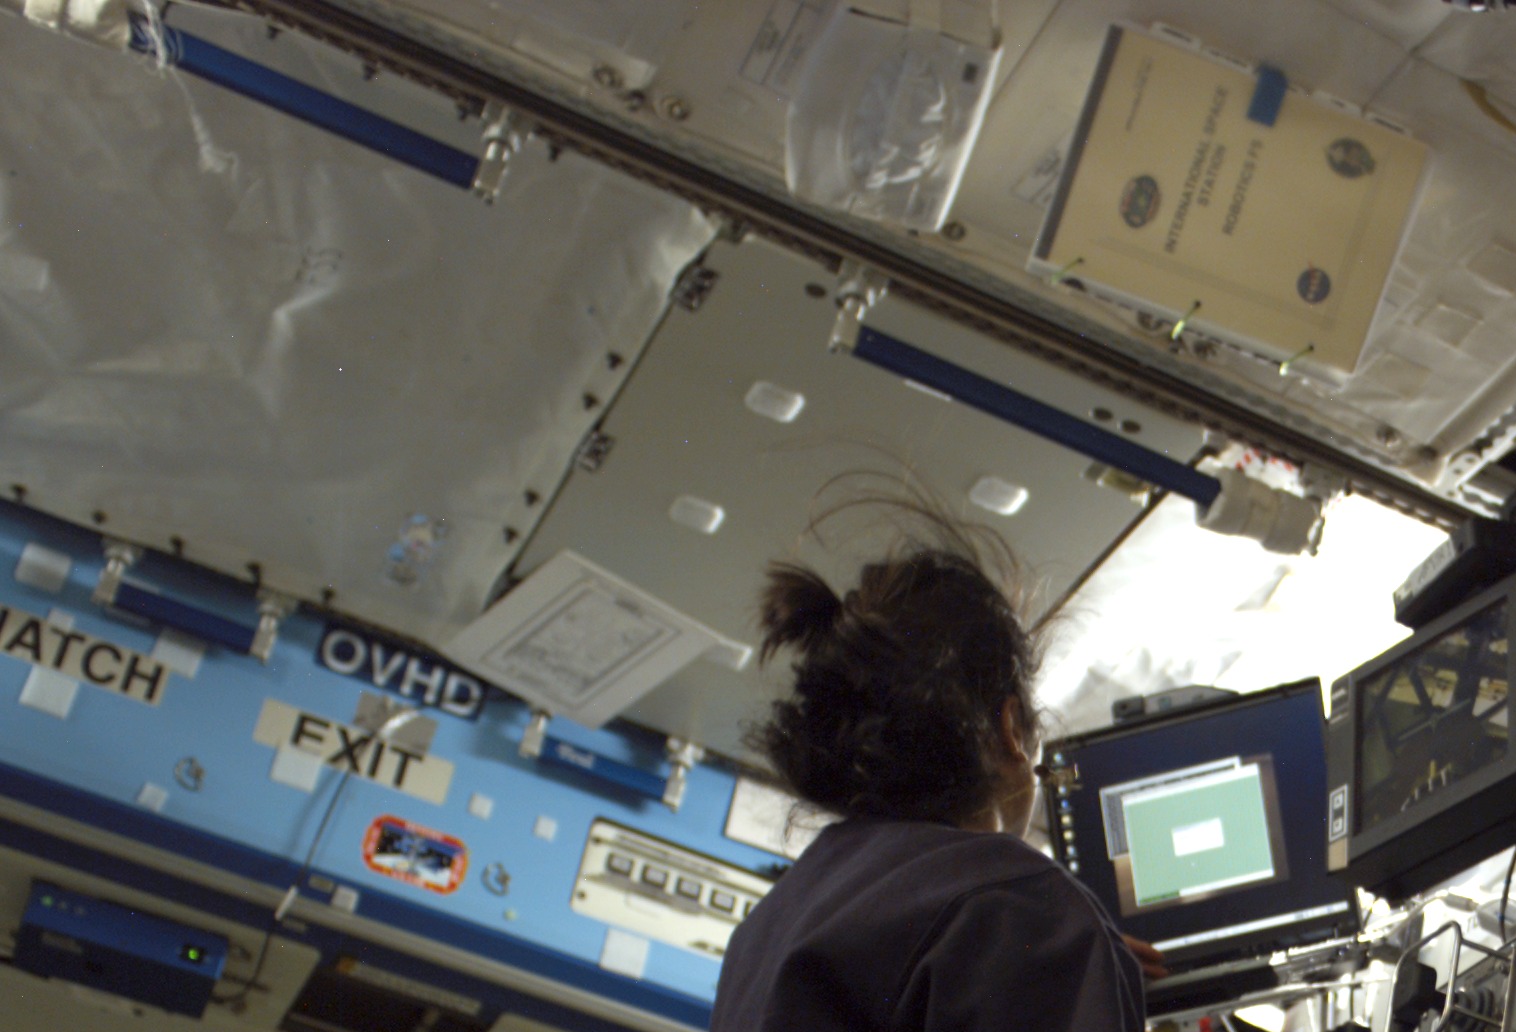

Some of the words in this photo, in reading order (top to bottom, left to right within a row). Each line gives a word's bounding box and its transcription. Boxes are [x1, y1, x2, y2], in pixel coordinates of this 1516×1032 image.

[1165, 142, 1210, 253] INTERNATIONAL
[1204, 85, 1229, 134] SPACE
[1197, 144, 1226, 208] STATION
[1222, 160, 1256, 236] ROBOTICS
[322, 629, 483, 717] OVHD
[290, 711, 424, 788] EXIT
